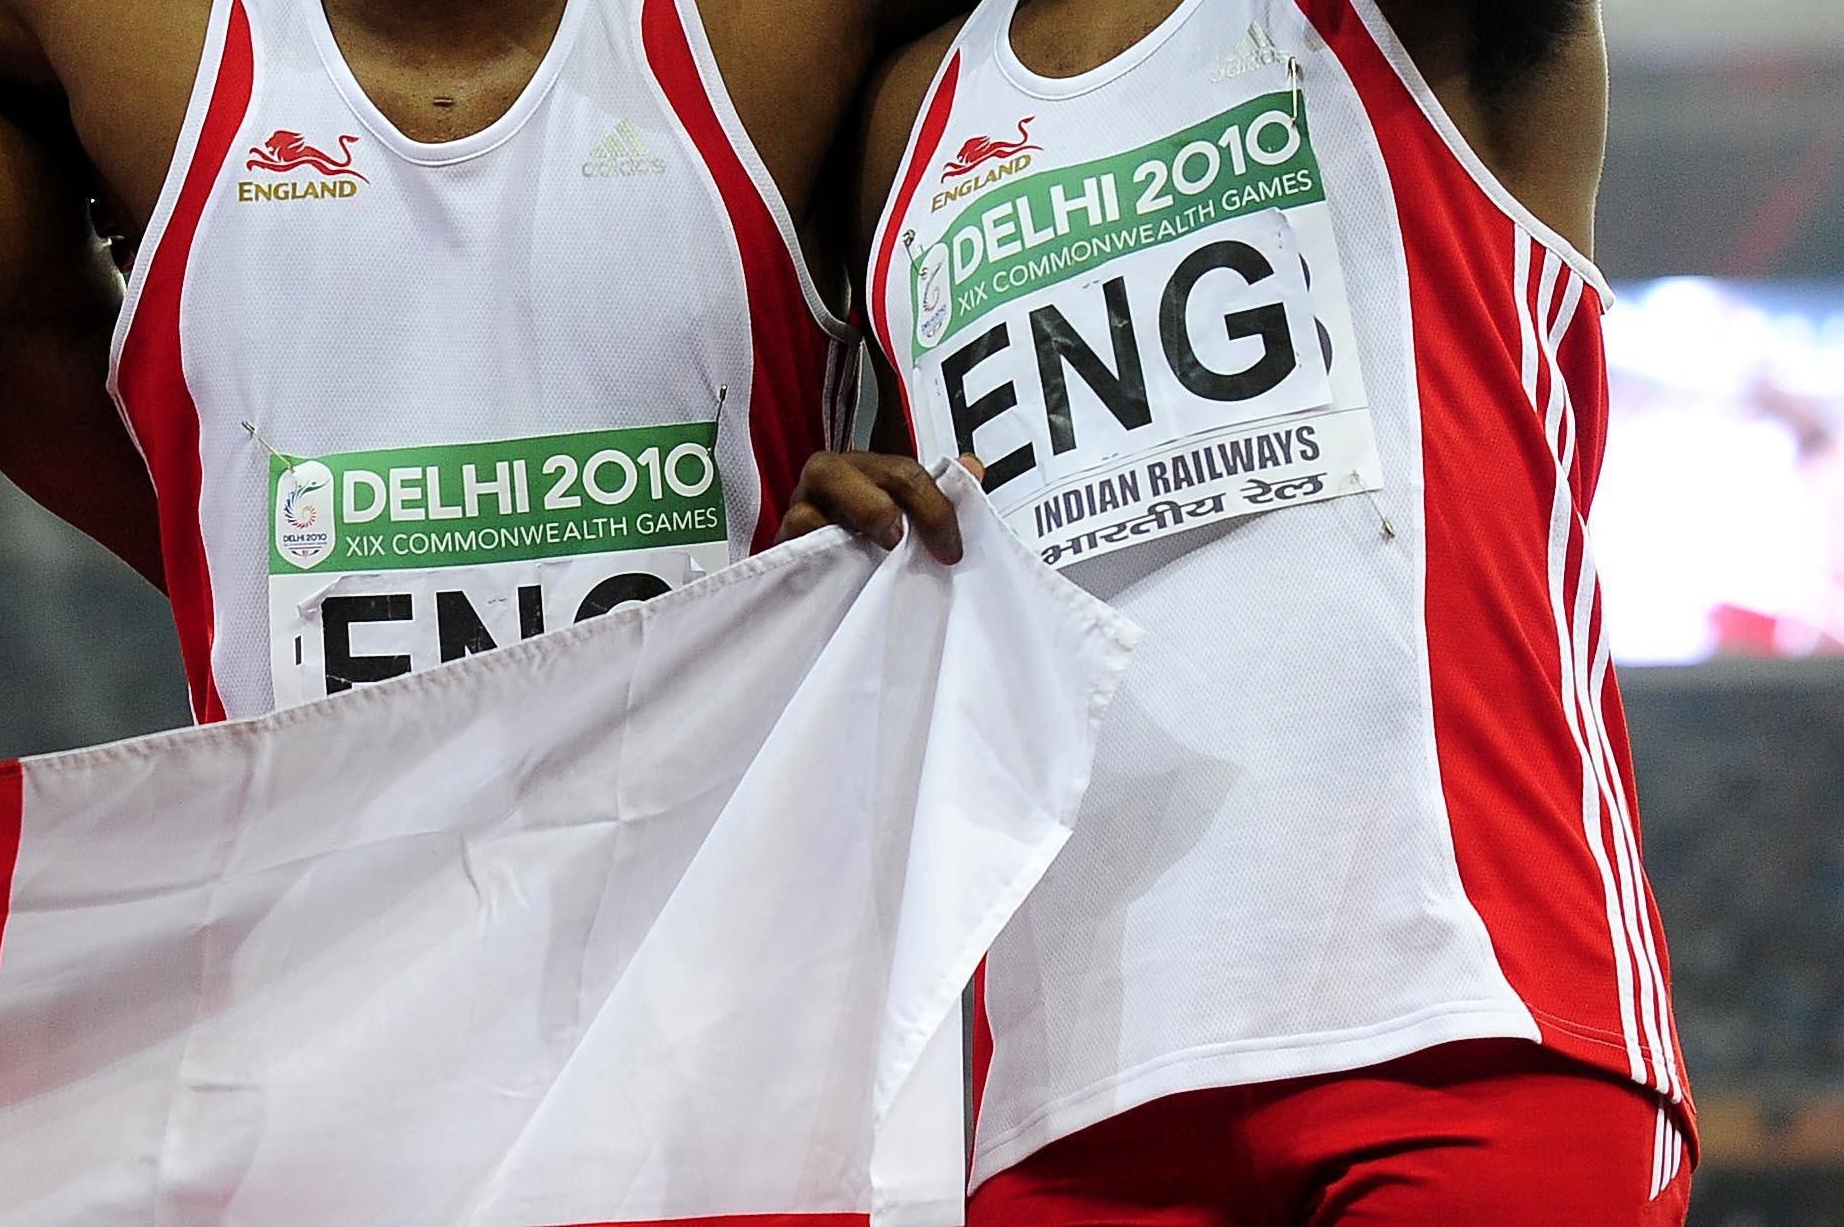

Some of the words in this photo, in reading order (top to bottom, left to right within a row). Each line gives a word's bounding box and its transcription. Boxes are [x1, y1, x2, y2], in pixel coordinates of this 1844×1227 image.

[238, 180, 357, 202] ENGLAND
[931, 154, 1032, 213] ENGLAND
[952, 173, 1120, 285] DELHI
[1133, 110, 1301, 215] 2010
[958, 279, 989, 316] XIX
[993, 199, 1216, 293] COMMONWEALTH
[1222, 169, 1313, 212] GAMES
[941, 240, 1297, 495] ENG
[342, 459, 530, 524] DELHI
[542, 442, 714, 510] 2010
[1034, 470, 1141, 538] INDIAN
[1146, 425, 1321, 497] RAILWAYS
[1040, 492, 1228, 565] भारतीय
[1239, 472, 1328, 505] रेल
[345, 534, 386, 558] XIX
[392, 516, 627, 556] COMMONWEALTH
[635, 507, 718, 536] GAMES
